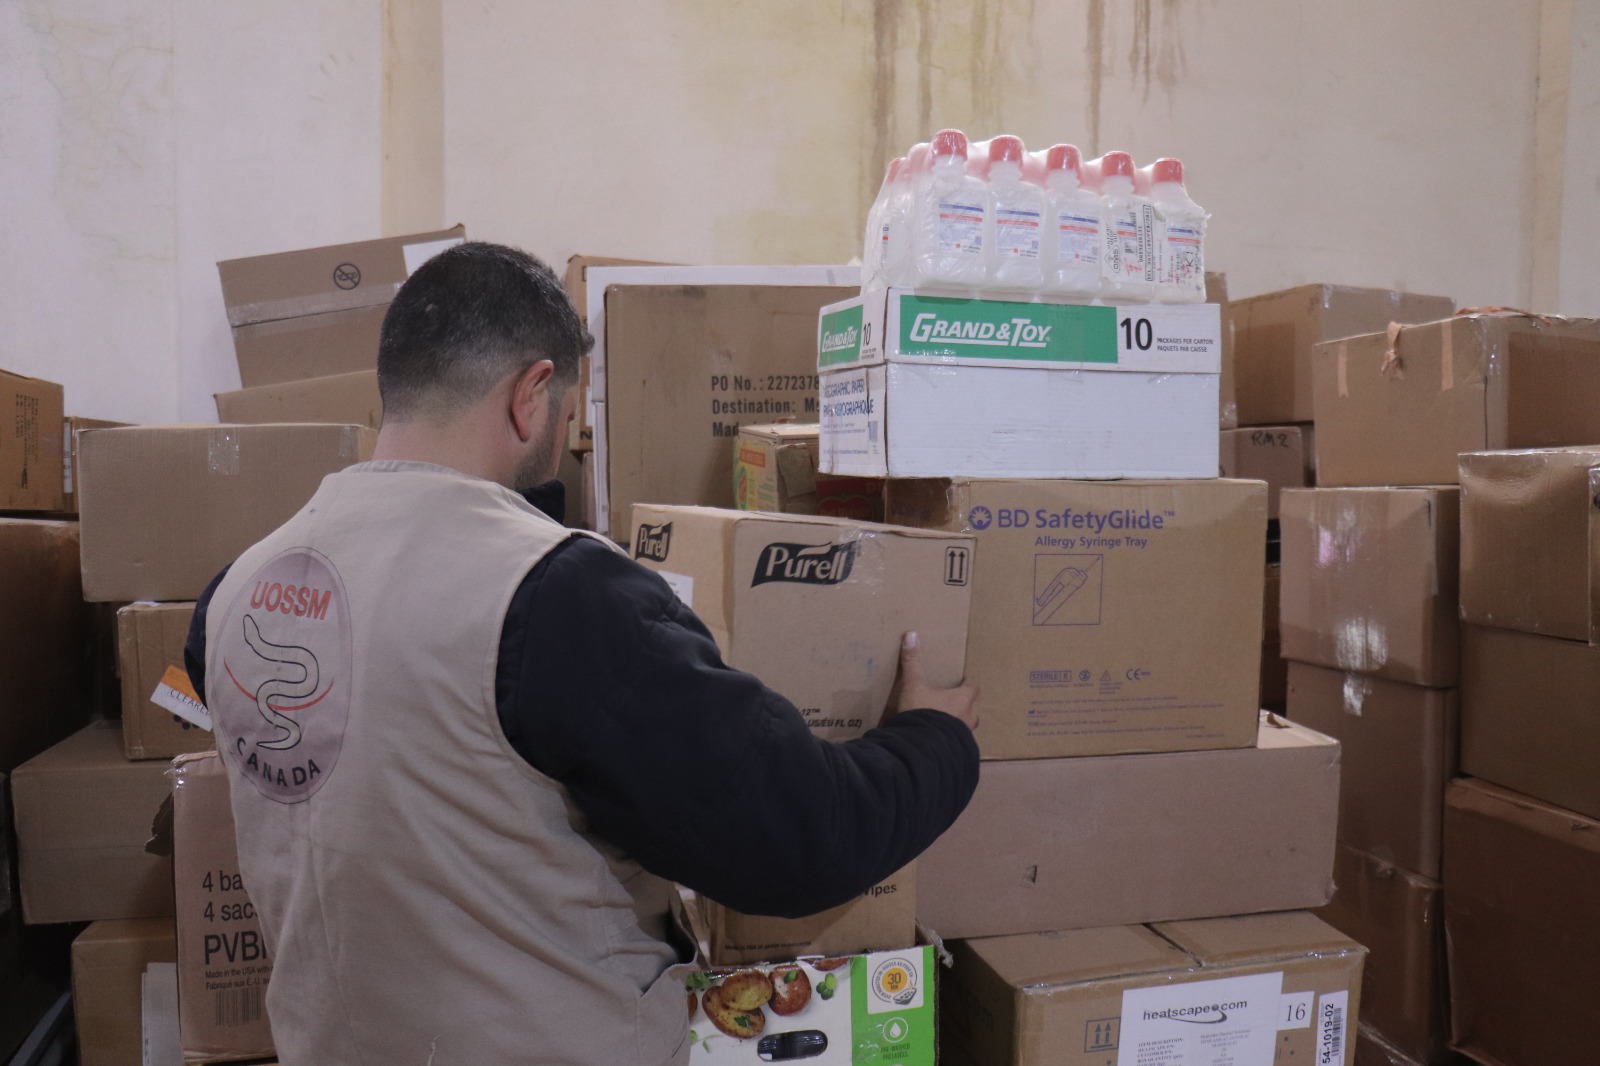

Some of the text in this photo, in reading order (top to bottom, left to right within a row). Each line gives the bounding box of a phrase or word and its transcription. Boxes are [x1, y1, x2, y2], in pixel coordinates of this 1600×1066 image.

[863, 323, 871, 346] 10
[1120, 317, 1153, 351] 10
[711, 375, 728, 392] PO
[712, 398, 796, 415] Destination:
[712, 421, 740, 438] Mad
[997, 509, 1030, 528] BD
[640, 527, 668, 559] Purell
[1035, 537, 1148, 549] Allergy Syringe Tray
[765, 545, 848, 581] Purell
[250, 581, 332, 621] UOSSM
[834, 719, 846, 728] FL
[237, 737, 321, 787] CANADA
[202, 870, 248, 894] 4 ba
[203, 901, 258, 923] 4 sac
[205, 969, 223, 979] Made
[224, 969, 230, 977] in
[231, 968, 241, 976] the
[242, 966, 256, 975] USA
[888, 972, 902, 985] 30
[1286, 1002, 1306, 1022] 16
[1322, 1003, 1335, 1064] 54-1019-02
